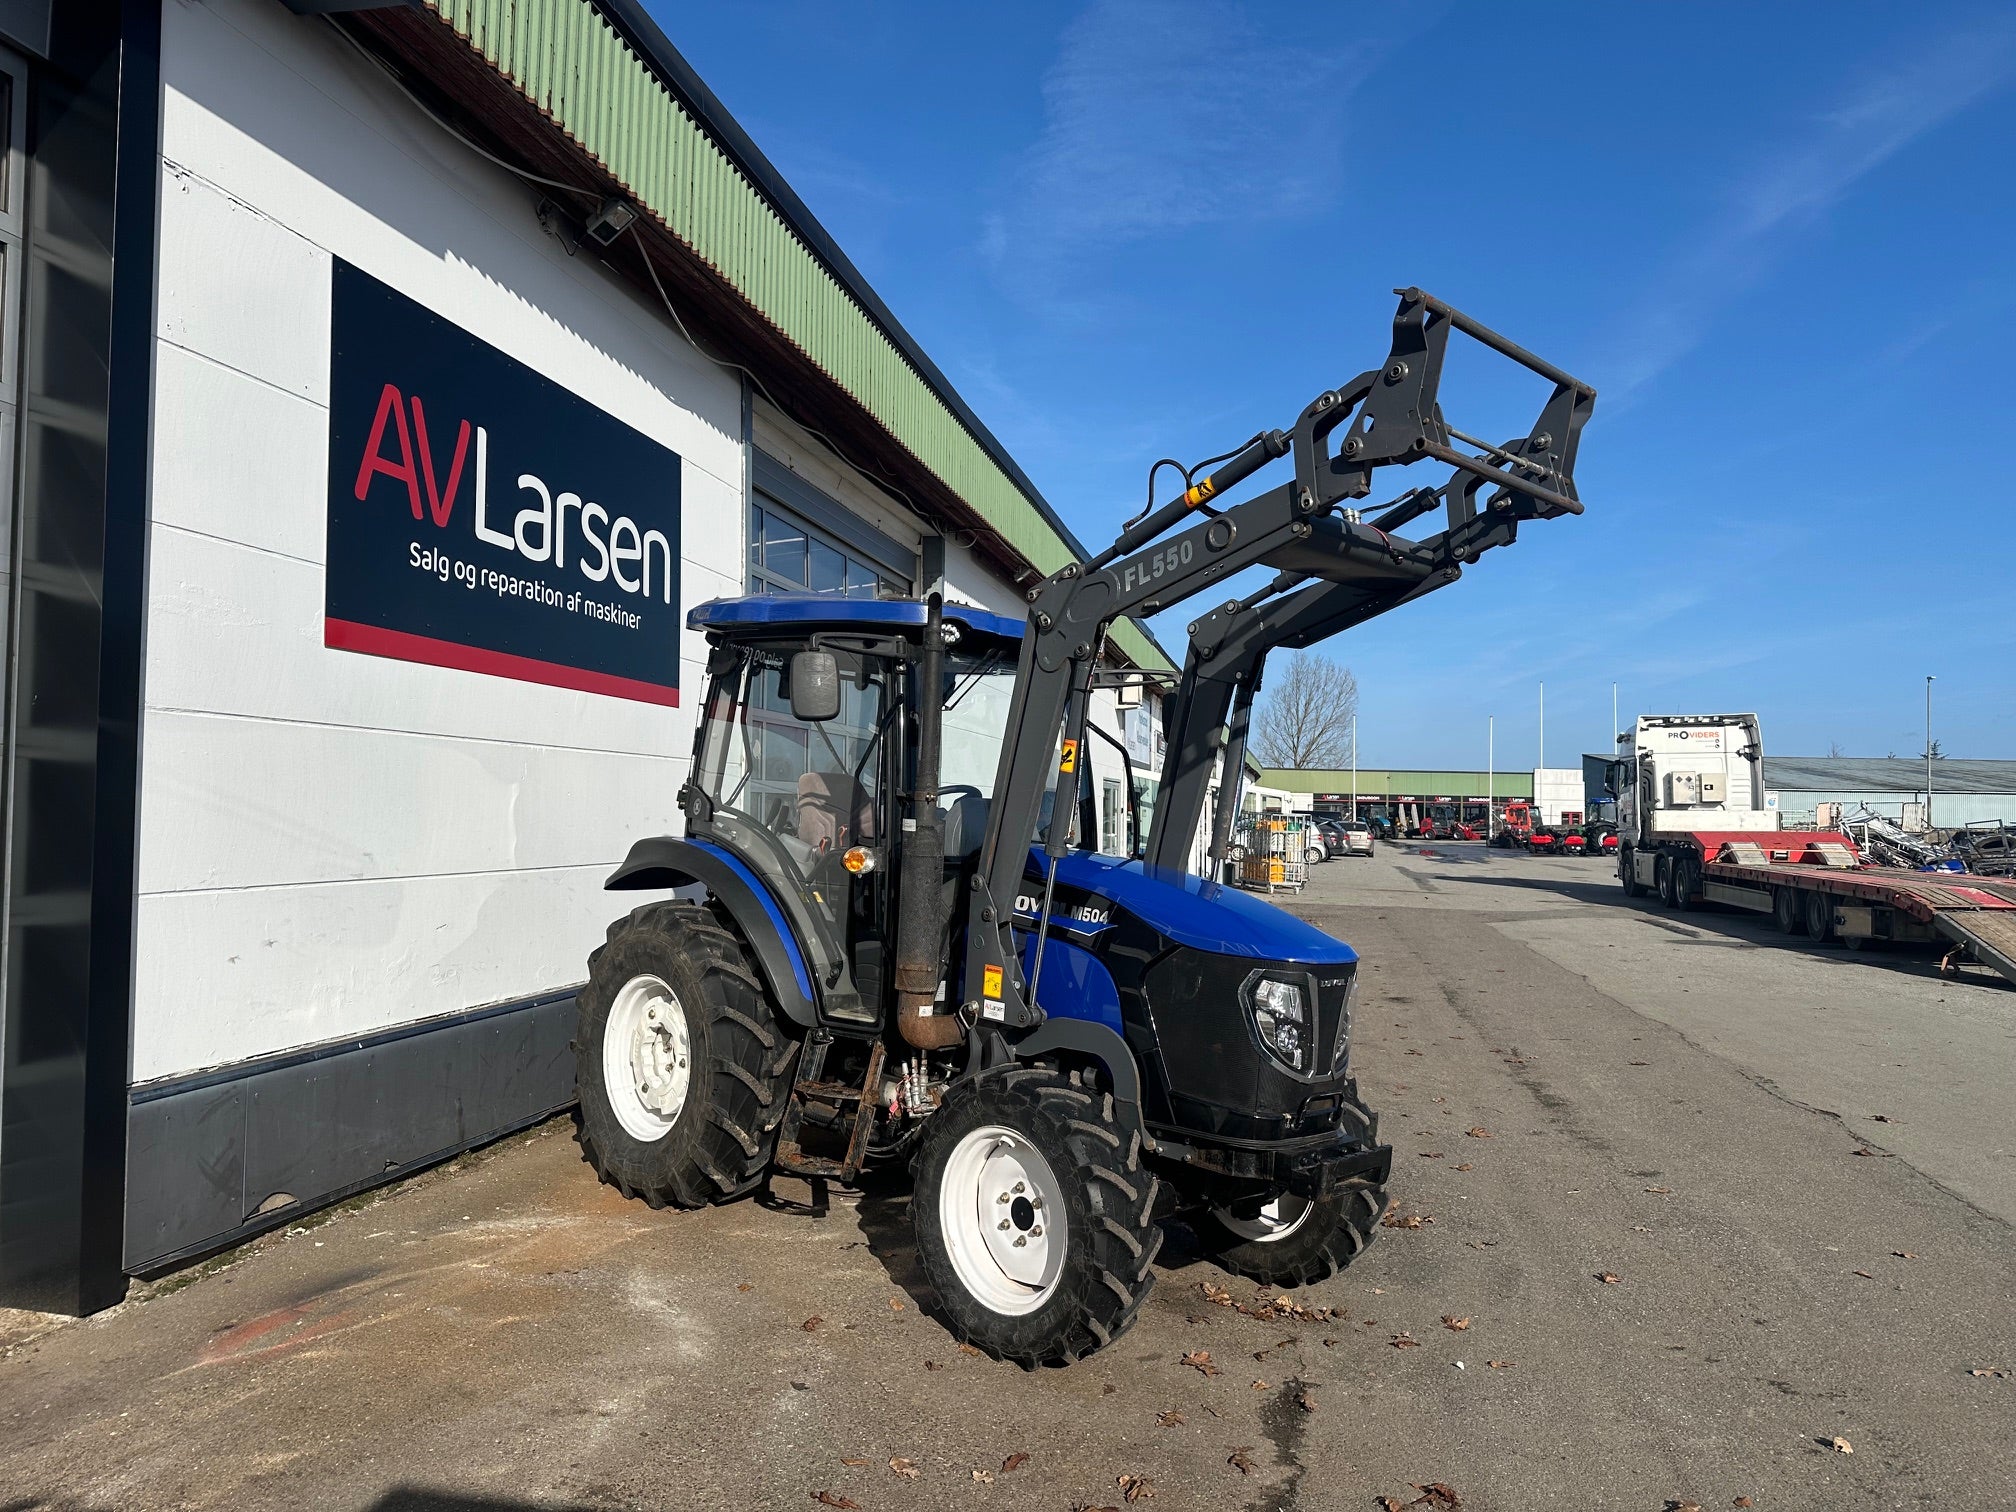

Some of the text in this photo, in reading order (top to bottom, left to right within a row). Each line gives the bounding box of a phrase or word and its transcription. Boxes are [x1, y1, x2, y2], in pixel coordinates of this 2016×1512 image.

[1124, 540, 1193, 592] FL550
[409, 541, 642, 630] Salg og reparation af maskiner
[1668, 730, 1720, 740] PROVIDERS
[1070, 904, 1109, 925] M504
